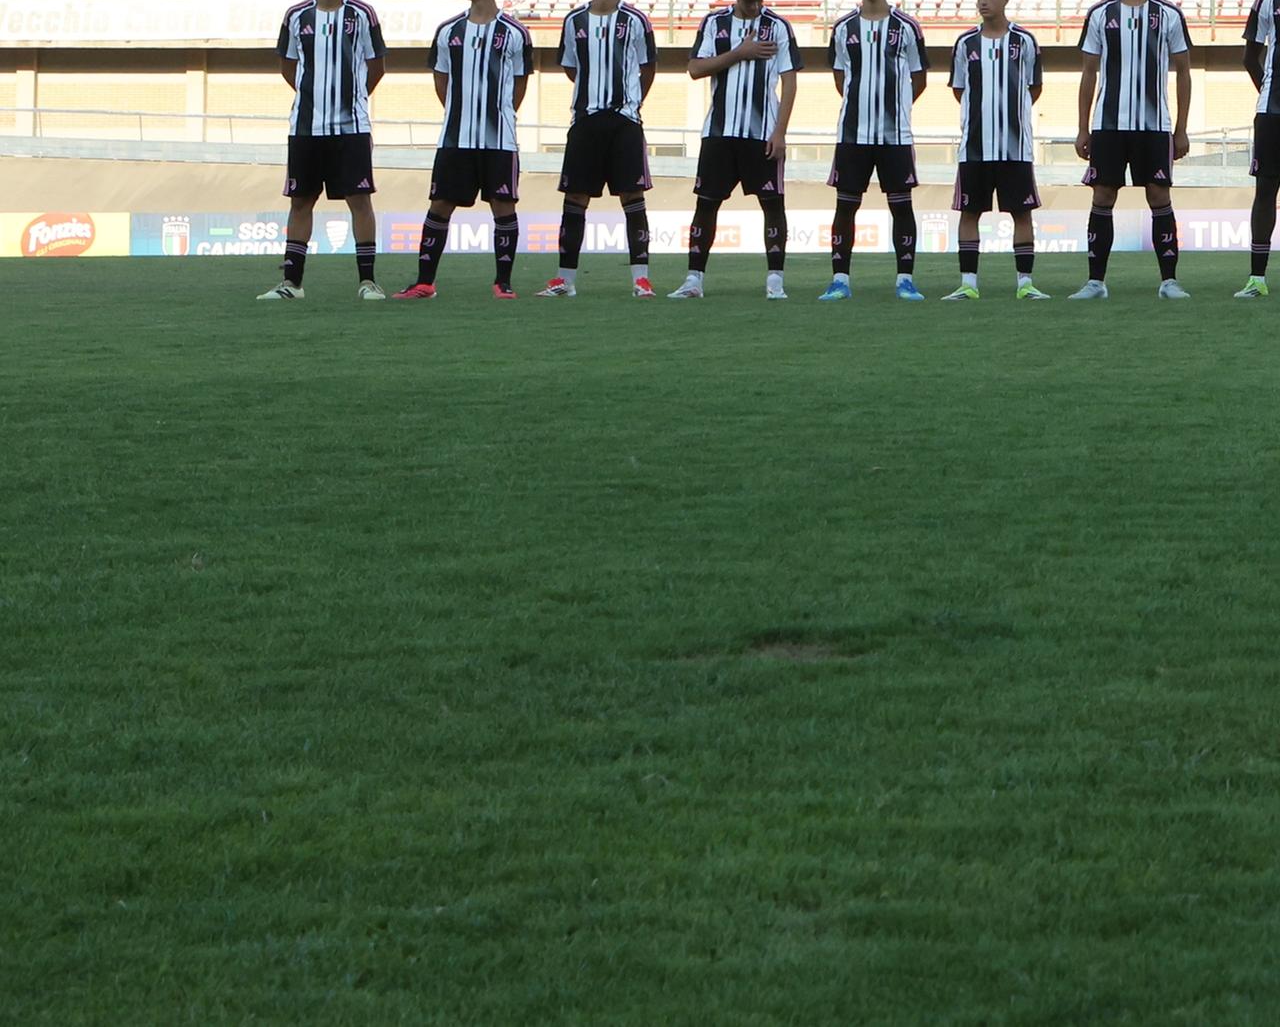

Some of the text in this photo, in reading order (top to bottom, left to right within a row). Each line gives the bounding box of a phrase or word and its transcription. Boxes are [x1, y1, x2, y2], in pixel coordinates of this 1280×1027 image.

[238, 222, 279, 240] SGS
[451, 223, 489, 250] IM
[586, 223, 625, 250] IM
[1189, 221, 1249, 248] TIM
